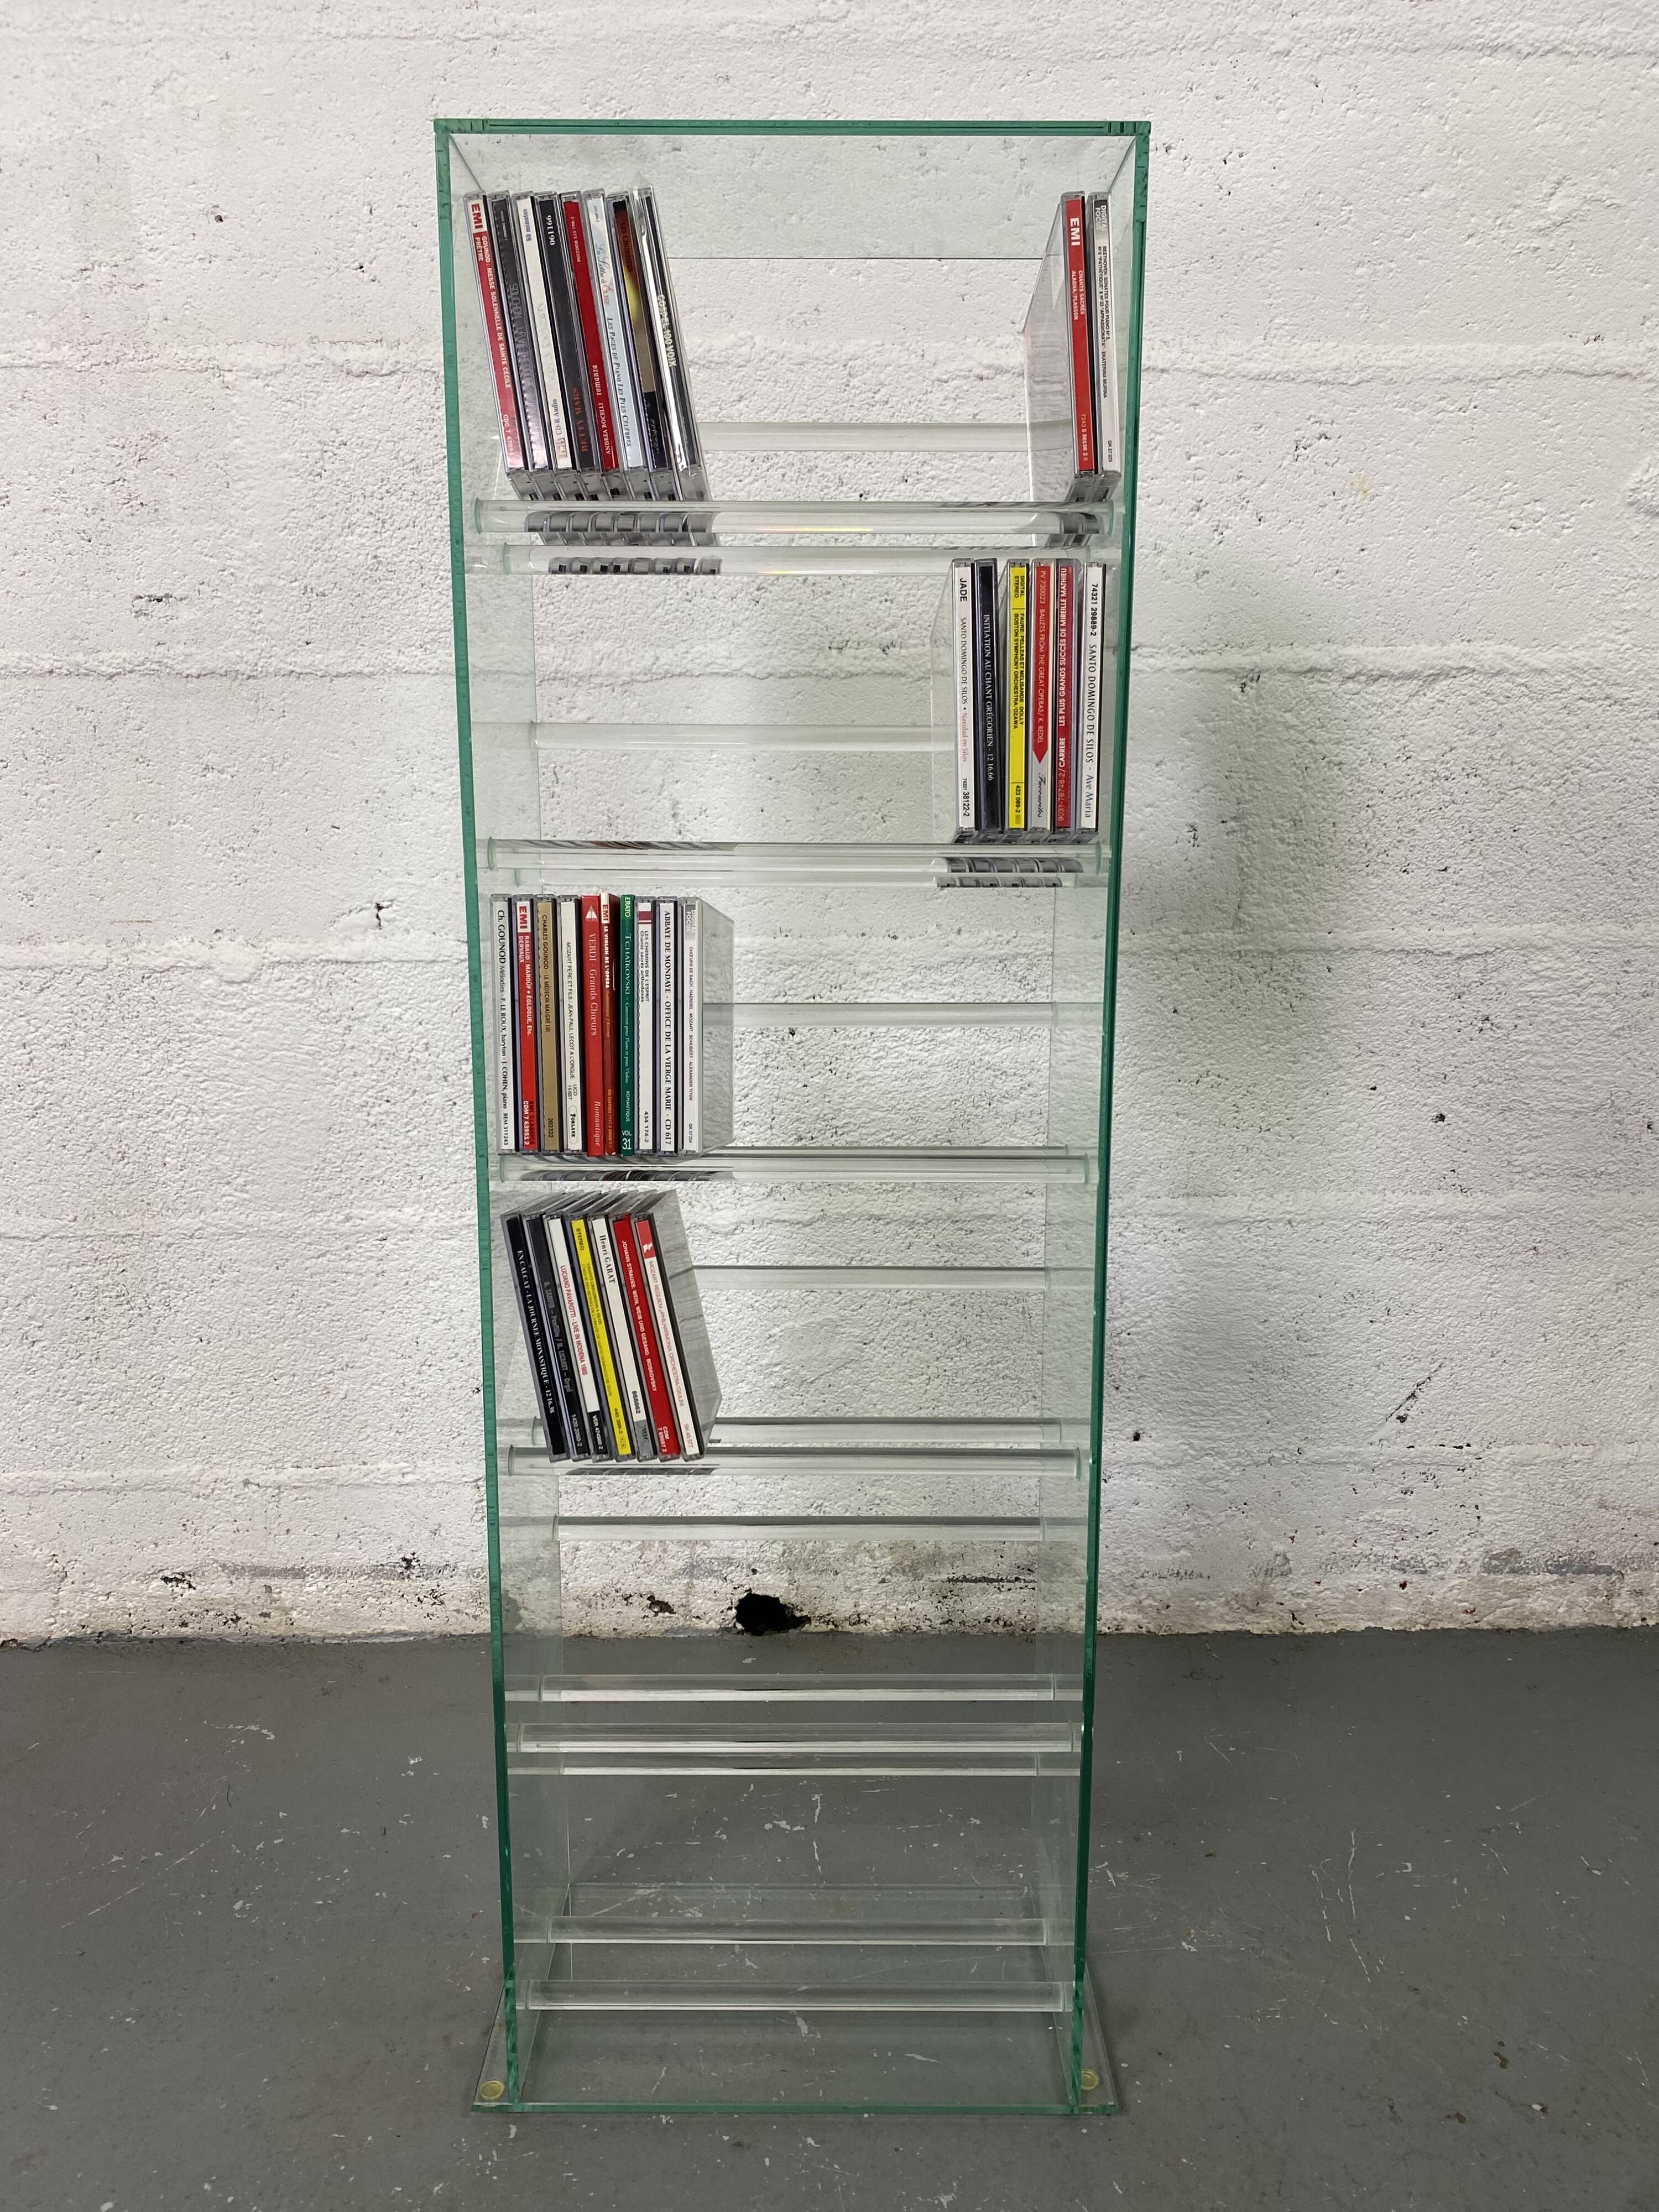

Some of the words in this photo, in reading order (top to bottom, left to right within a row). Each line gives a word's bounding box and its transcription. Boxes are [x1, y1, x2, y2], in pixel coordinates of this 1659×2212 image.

[471, 203, 483, 229] EMI
[521, 209, 530, 232] minutes
[545, 215, 556, 246] 061166
[1070, 217, 1081, 246] EMI
[487, 268, 495, 289] MESSE
[491, 291, 502, 331] SOLENNELLE
[497, 332, 503, 341] DE
[663, 329, 673, 345] 100
[499, 343, 507, 365] SAINTE
[666, 345, 677, 367] VOIX
[592, 364, 602, 395] romanza
[551, 399, 560, 417] Audio
[571, 387, 583, 416] MARS
[554, 418, 562, 435] CD-R
[598, 403, 607, 428] BOCELLI
[577, 420, 588, 452] BETTY
[602, 429, 611, 455] ANDREA
[1060, 628, 1066, 637] DE
[984, 659, 991, 670] AU
[1088, 645, 1097, 672] SANTO
[1087, 676, 1096, 721] DOMINGO
[986, 703, 994, 747] GRÉGORIEN
[1087, 724, 1094, 735] DE
[1086, 739, 1094, 763] SILOS
[1037, 773, 1046, 817] Favourites
[1085, 792, 1093, 817] Maria
[588, 933, 596, 961] VERDI
[665, 942, 670, 952] DE
[665, 1031, 671, 1042] DE
[665, 1045, 671, 1053] LA
[592, 1102, 601, 1146] Romantique
[665, 1119, 671, 1130] CD
[622, 1138, 632, 1150] 31
[576, 1228, 585, 1251] STEREO
[517, 1250, 524, 1260] EN
[599, 1235, 609, 1255] Henri
[604, 1257, 615, 1284] GARAT
[519, 1261, 530, 1290] CALCAT
[649, 1261, 658, 1284] MOZART
[654, 1285, 664, 1309] REQUIEM
[526, 1295, 533, 1304] LA
[560, 1265, 570, 1288] LUCIANO
[565, 1289, 576, 1318] PAVAROTTI
[576, 1340, 585, 1363] MODENA
[622, 1240, 631, 1262] JOHANN
[641, 1333, 650, 1355] GESANG
[646, 1358, 658, 1391] BOSKOVSKY
[534, 1338, 549, 1385] MONASTIQUE
